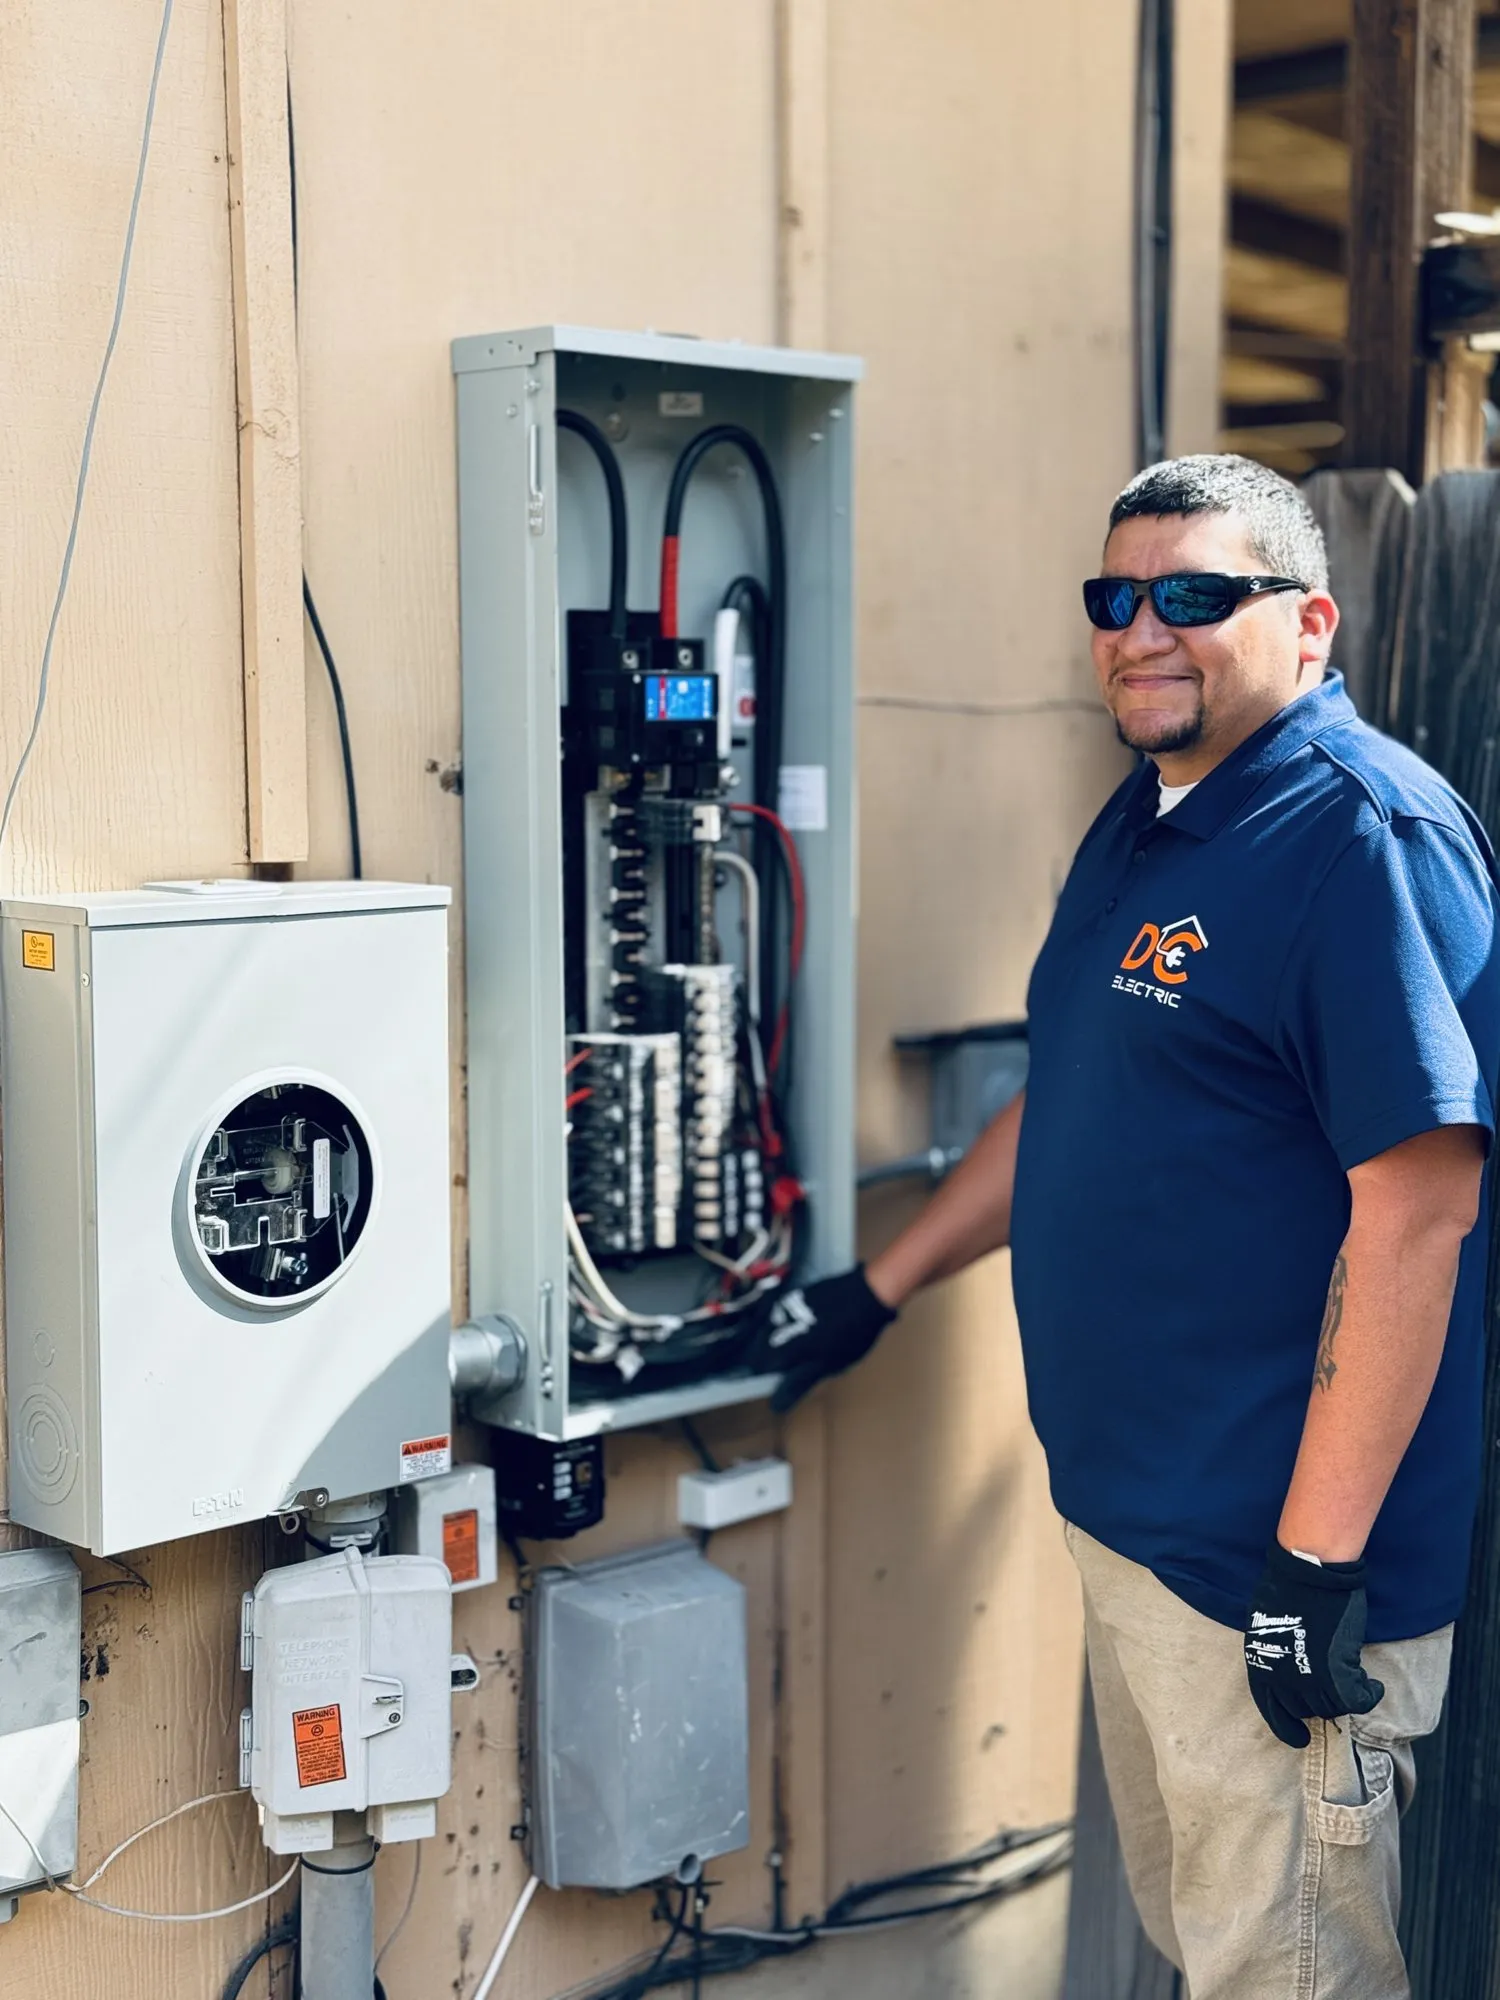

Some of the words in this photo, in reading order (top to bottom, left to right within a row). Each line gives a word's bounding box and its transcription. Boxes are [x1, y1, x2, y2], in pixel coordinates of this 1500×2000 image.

[1120, 922, 1203, 985] DC
[1111, 974, 1182, 1009] ELECTRIC
[411, 1437, 448, 1454] WARNING
[1251, 1611, 1302, 1628] Milwaukee
[280, 1637, 350, 1653] TELEPHONE
[284, 1654, 345, 1669] NETWORK
[282, 1669, 349, 1684] INTERFACE
[296, 1708, 336, 1722] WARNING
